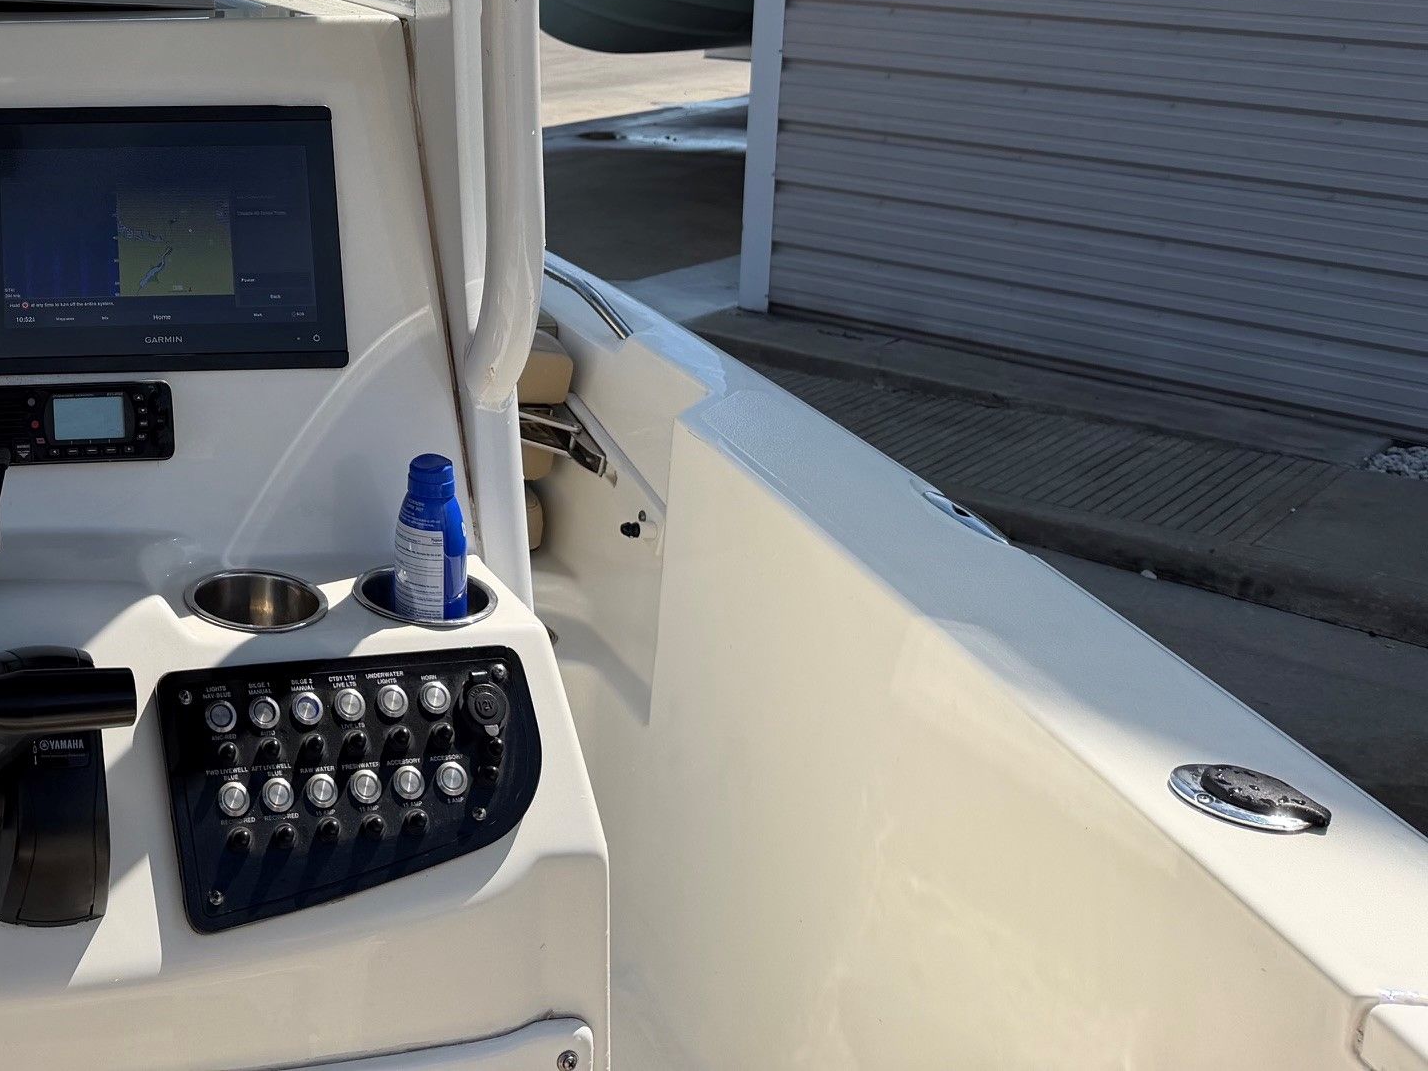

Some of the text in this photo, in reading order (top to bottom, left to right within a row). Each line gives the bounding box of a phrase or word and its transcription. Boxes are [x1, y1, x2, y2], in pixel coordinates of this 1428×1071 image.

[144, 335, 183, 344] GARMIN
[364, 671, 405, 680] UNDERWATER
[49, 739, 85, 750] YAMAHA
